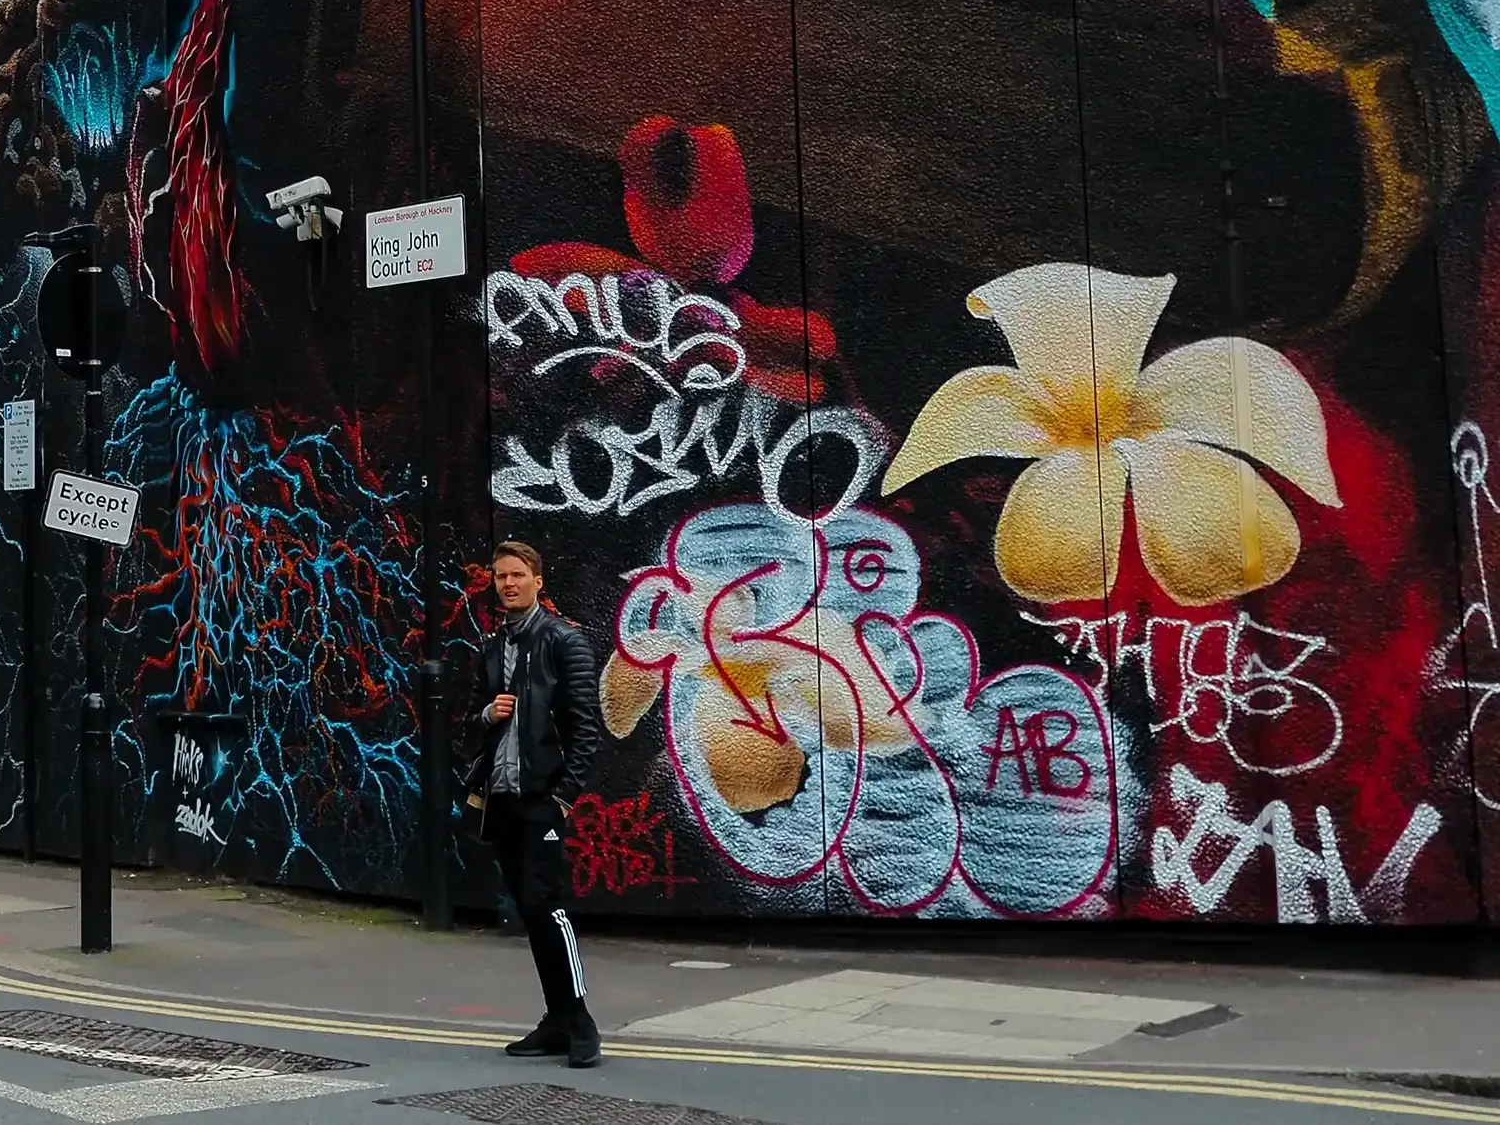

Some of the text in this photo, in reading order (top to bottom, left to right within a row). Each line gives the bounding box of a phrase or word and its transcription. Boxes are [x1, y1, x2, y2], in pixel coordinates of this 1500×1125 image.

[374, 206, 453, 224] London Borough of Hackney
[371, 229, 438, 257] King John
[371, 255, 433, 279] Court EC2
[421, 475, 428, 487] 5
[60, 482, 129, 513] Except
[58, 508, 120, 530] cycles
